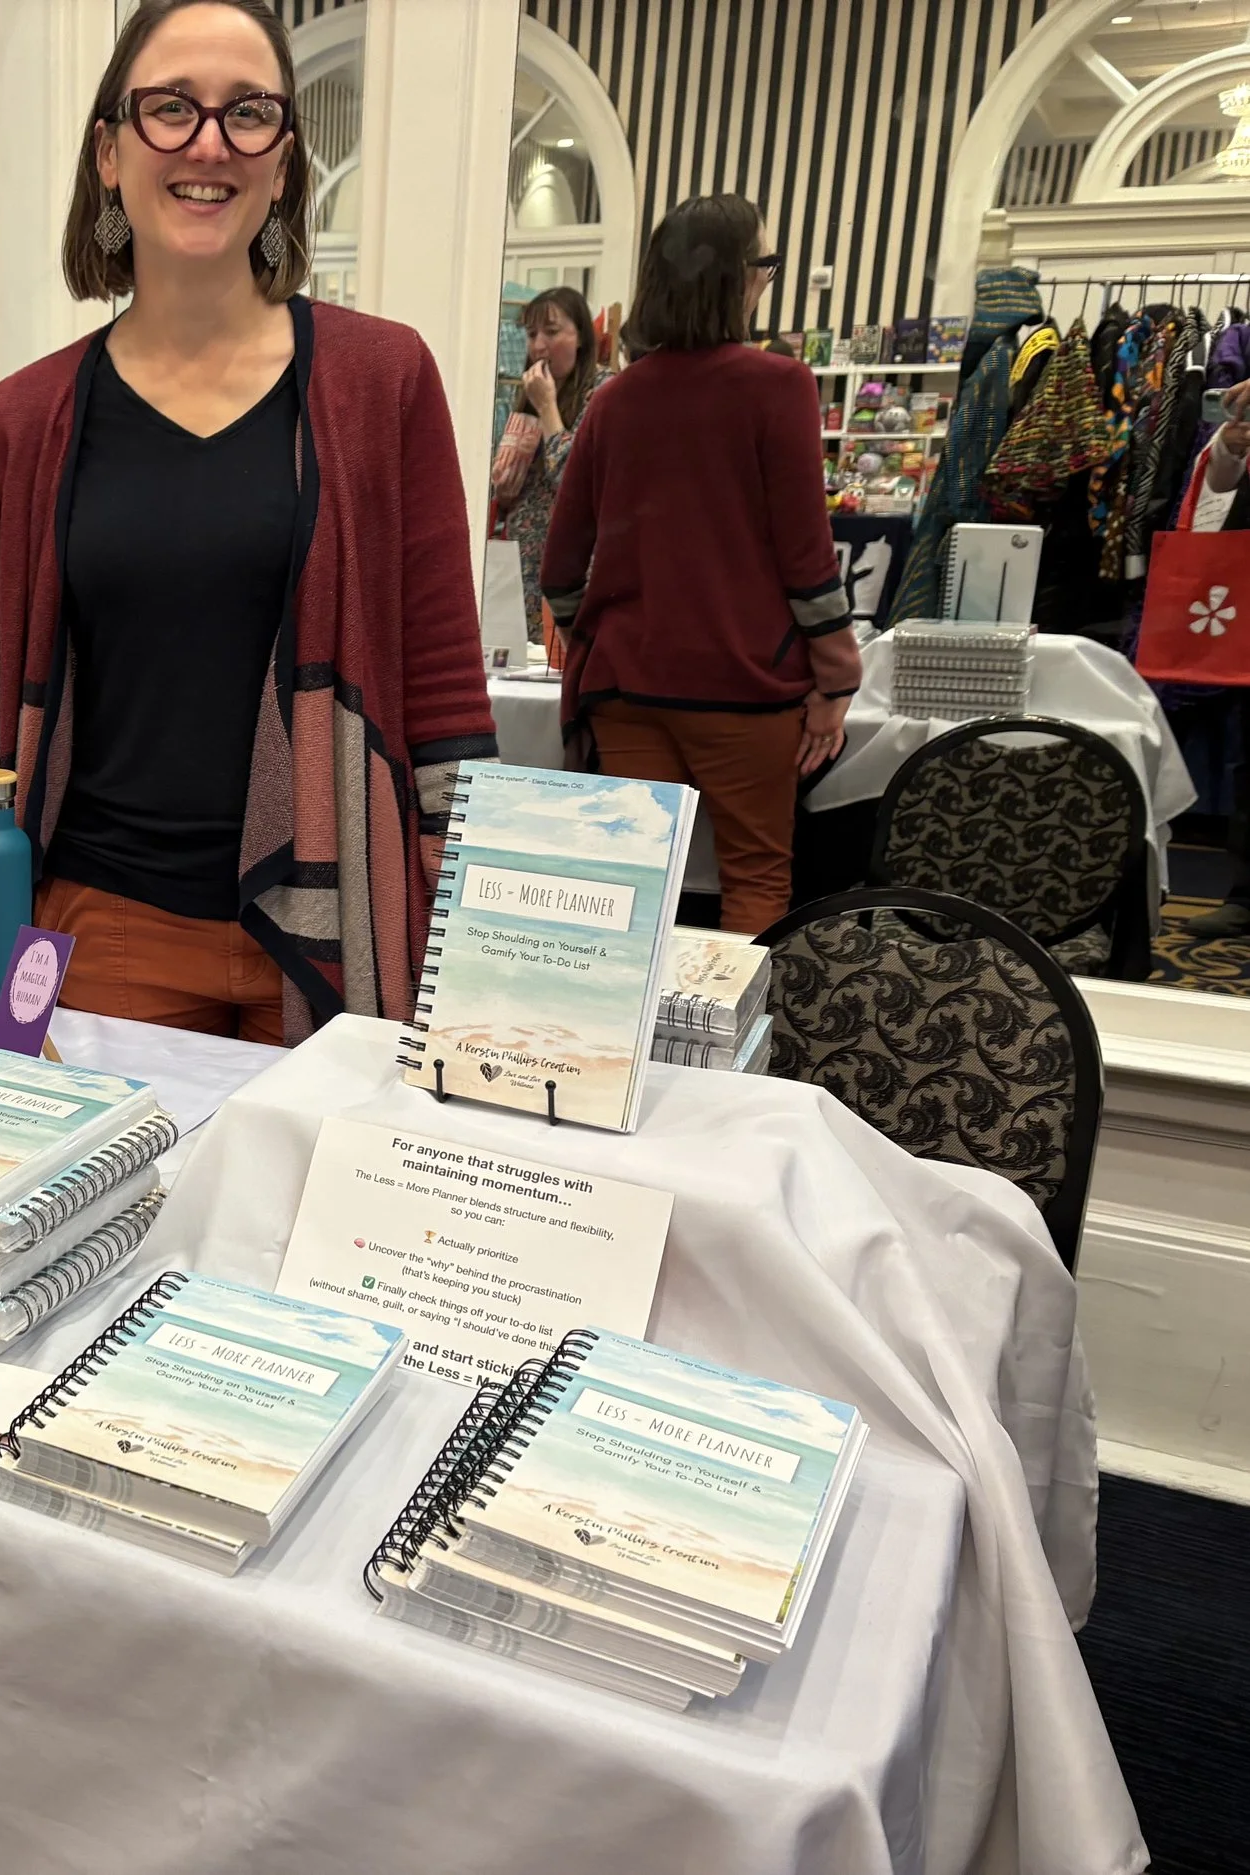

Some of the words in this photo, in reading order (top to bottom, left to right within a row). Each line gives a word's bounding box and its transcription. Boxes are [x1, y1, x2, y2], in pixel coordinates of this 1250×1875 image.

[478, 877, 502, 900] LESS
[518, 883, 553, 908] MORE
[556, 888, 614, 917] PLANNER
[466, 926, 490, 940] Stop
[491, 930, 540, 949] Shoulding
[558, 940, 597, 955] Yourself
[599, 947, 606, 957] &
[481, 944, 516, 960] Gamify
[519, 950, 540, 962] Your
[542, 954, 571, 967] To-Do
[573, 958, 590, 970] List
[20, 971, 48, 987] MAGICAL
[392, 1137, 414, 1151] For
[416, 1145, 464, 1163] anyone
[467, 1155, 494, 1170] that
[496, 1163, 560, 1185] struggles
[564, 1179, 592, 1193] with
[402, 1159, 478, 1186] maintaining
[481, 1178, 571, 1206] momentum...
[450, 1207, 462, 1215] so
[463, 1210, 482, 1220] you
[484, 1215, 505, 1226] can:
[437, 1235, 475, 1254] Actually
[476, 1247, 518, 1263] prioritize
[368, 1241, 407, 1258] Uncover
[408, 1252, 424, 1263] the
[455, 1264, 489, 1280] behind
[491, 1274, 506, 1285] the
[508, 1280, 581, 1304] procrastination
[432, 1273, 470, 1292] keeping
[470, 1285, 490, 1296] you
[491, 1290, 521, 1306] stuck)
[168, 1332, 196, 1349] LESS
[211, 1345, 251, 1365] MORE
[250, 1356, 314, 1384] PLANNER
[596, 1400, 627, 1420] LESS
[648, 1418, 692, 1442] MORE
[697, 1433, 772, 1468] PLANNER
[575, 1428, 605, 1442] Stop
[608, 1438, 672, 1465] Shoulding
[675, 1462, 691, 1470] on
[697, 1466, 748, 1488] Yourself
[751, 1485, 760, 1493] &
[592, 1444, 639, 1465] Gamify
[644, 1460, 671, 1474] Your
[675, 1470, 712, 1488] To-Do
[716, 1484, 737, 1496] List
